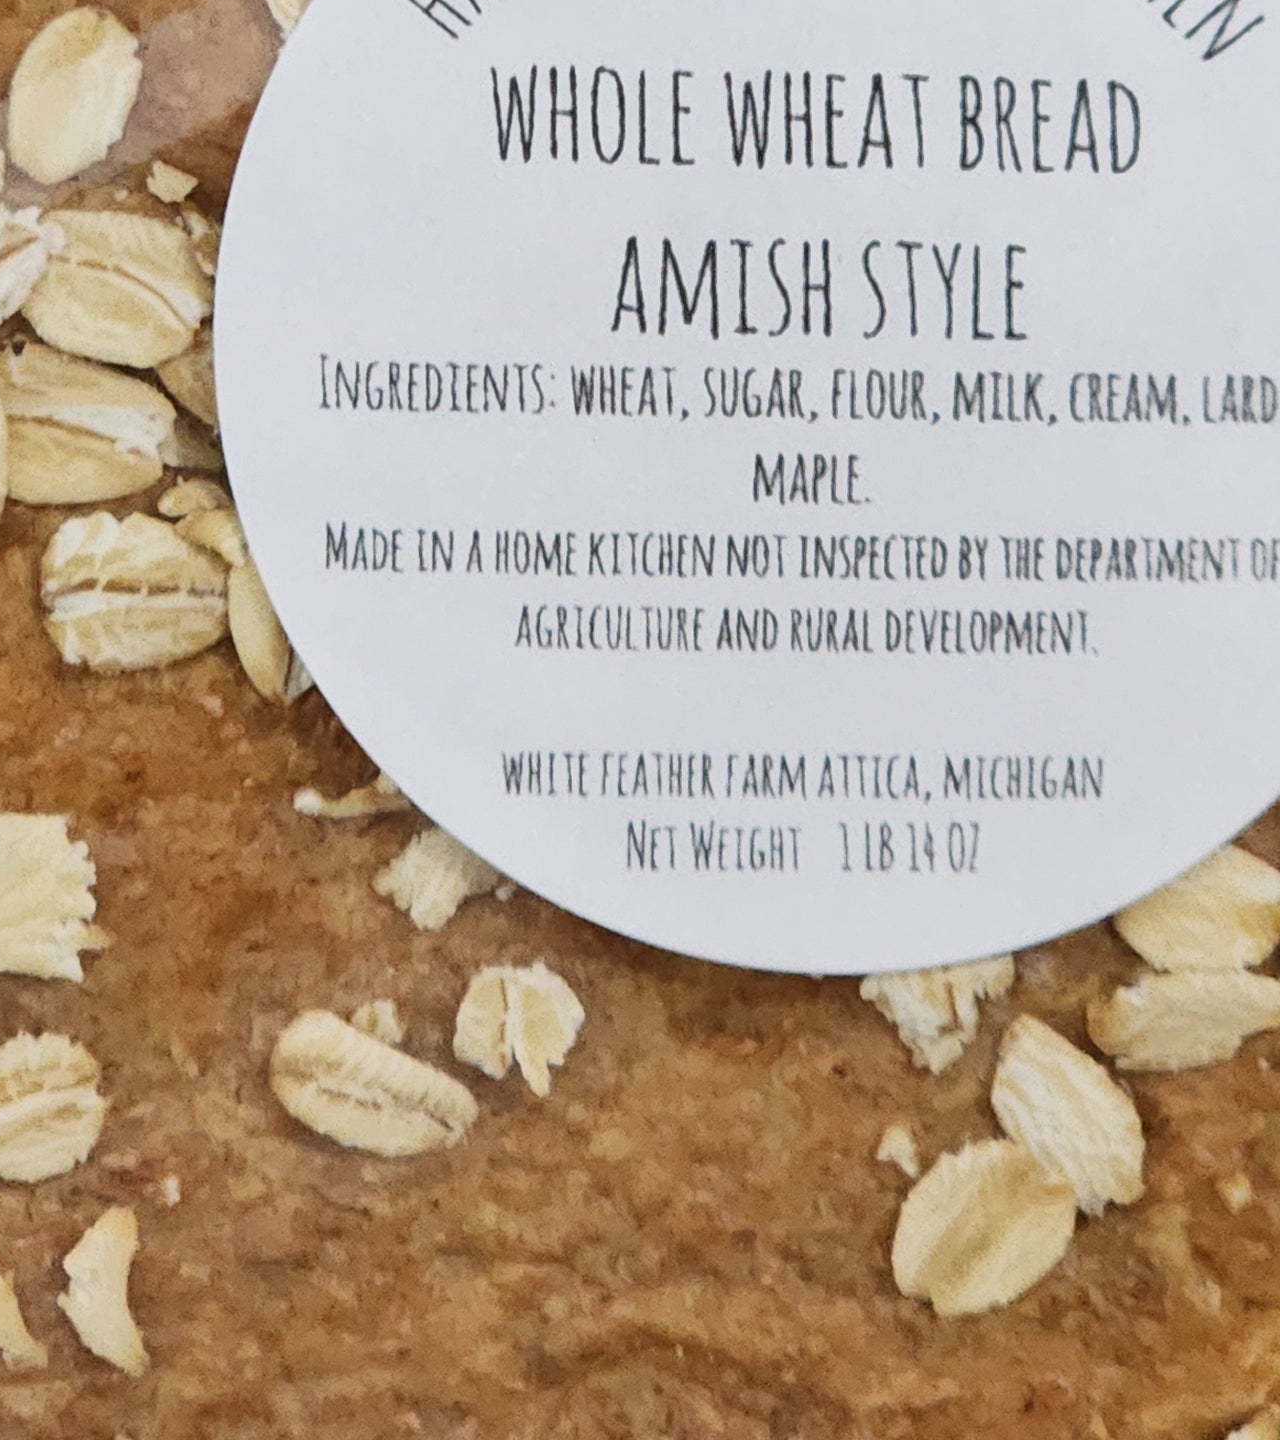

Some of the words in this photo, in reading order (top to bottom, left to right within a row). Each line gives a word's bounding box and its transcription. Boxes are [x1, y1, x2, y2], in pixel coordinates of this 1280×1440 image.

[490, 64, 695, 166] WHOLE
[723, 69, 929, 170] WHEAT
[959, 74, 1141, 174] BREAD
[611, 235, 832, 340] AMISH
[862, 240, 1028, 341] STYLE
[320, 353, 555, 414] INGREDIENTS:
[571, 364, 689, 422] WHEAT,
[704, 366, 818, 424] SUGAR,
[832, 368, 941, 425] FLOUR,
[952, 371, 1058, 426] MILK,
[753, 453, 871, 506] MAPLE.
[326, 520, 403, 573] MADE
[417, 528, 454, 572] IN
[466, 529, 483, 573] A
[495, 529, 576, 577] HOME
[588, 532, 715, 578] KITCHEN
[727, 534, 787, 578] NOT
[800, 534, 948, 581] INSPECTED
[959, 535, 988, 581] BY
[999, 535, 1044, 581] THE
[1056, 537, 1240, 583] DEPARTMENT
[515, 604, 704, 652] AGRICULTURE
[716, 607, 779, 652] AND
[791, 607, 873, 653] RURAL
[885, 609, 1097, 655] DEVELOPMENT.
[502, 750, 588, 798] WHITE
[601, 752, 714, 798] FEATHER
[726, 754, 806, 800] FARM
[818, 754, 931, 804] ATTICA,
[944, 755, 1103, 801] MICHIGAN
[627, 819, 675, 871] NET
[690, 820, 798, 871] WEIGHT
[865, 822, 894, 872] LB
[907, 823, 935, 872] 14
